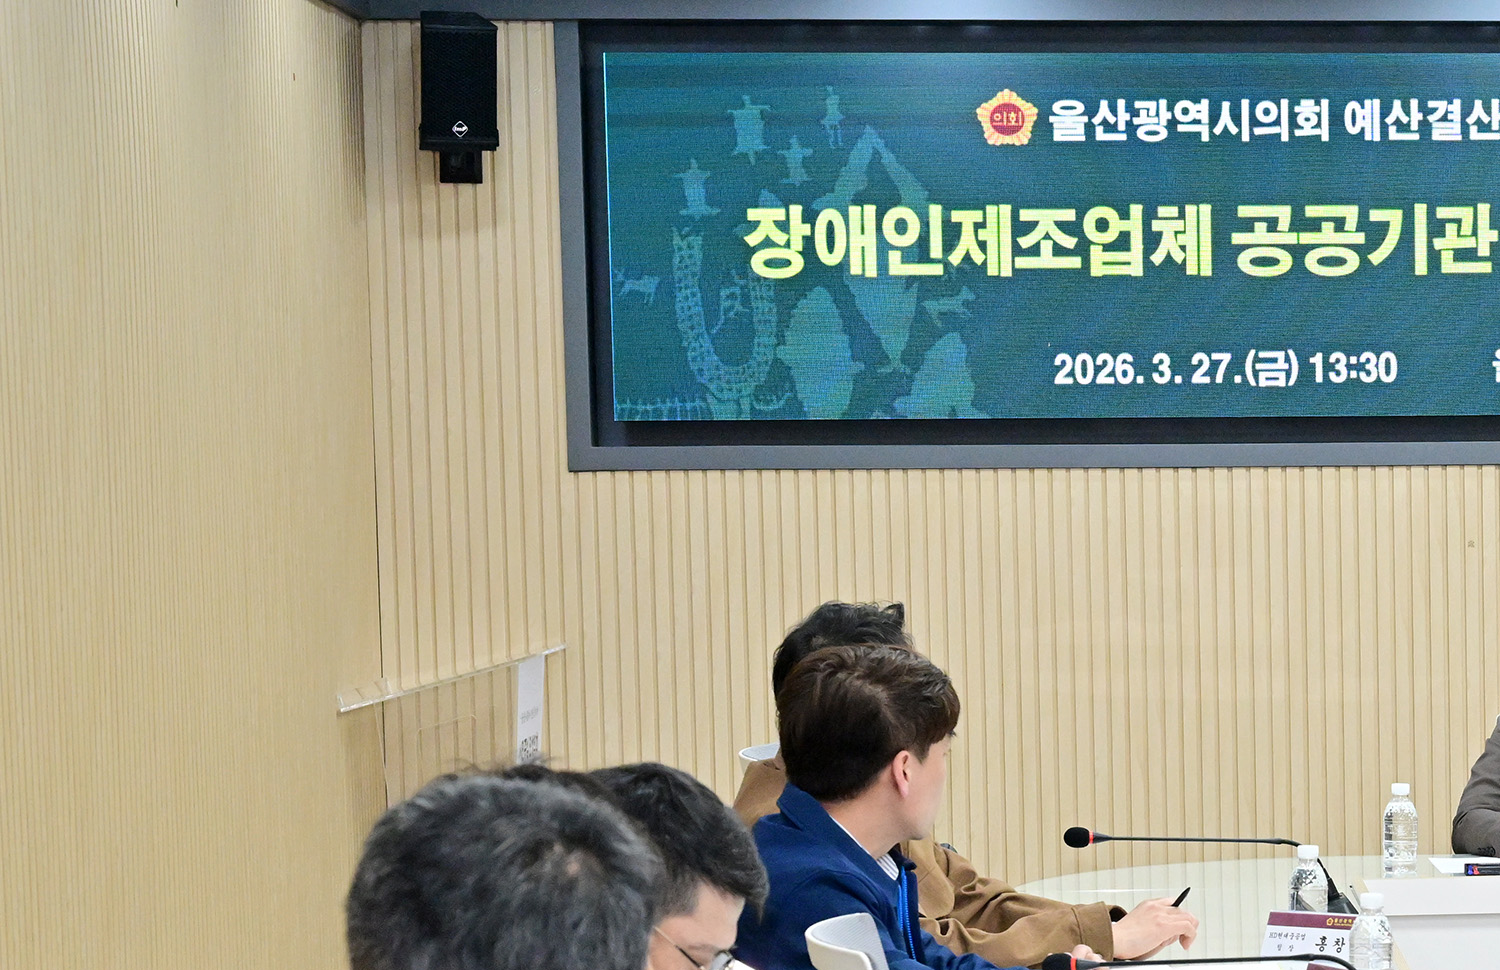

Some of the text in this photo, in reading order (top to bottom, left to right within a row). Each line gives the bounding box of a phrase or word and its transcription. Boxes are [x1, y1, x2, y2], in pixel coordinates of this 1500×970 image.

[992, 111, 1022, 127] 의회
[1048, 98, 1331, 143] 울산광역시의회
[743, 204, 1213, 279] 장애인제조업체
[1231, 202, 1500, 277] 공공기관
[1053, 349, 1398, 388] 2026. 3. 27.(금) 13:30
[1315, 935, 1346, 953] 홍창
